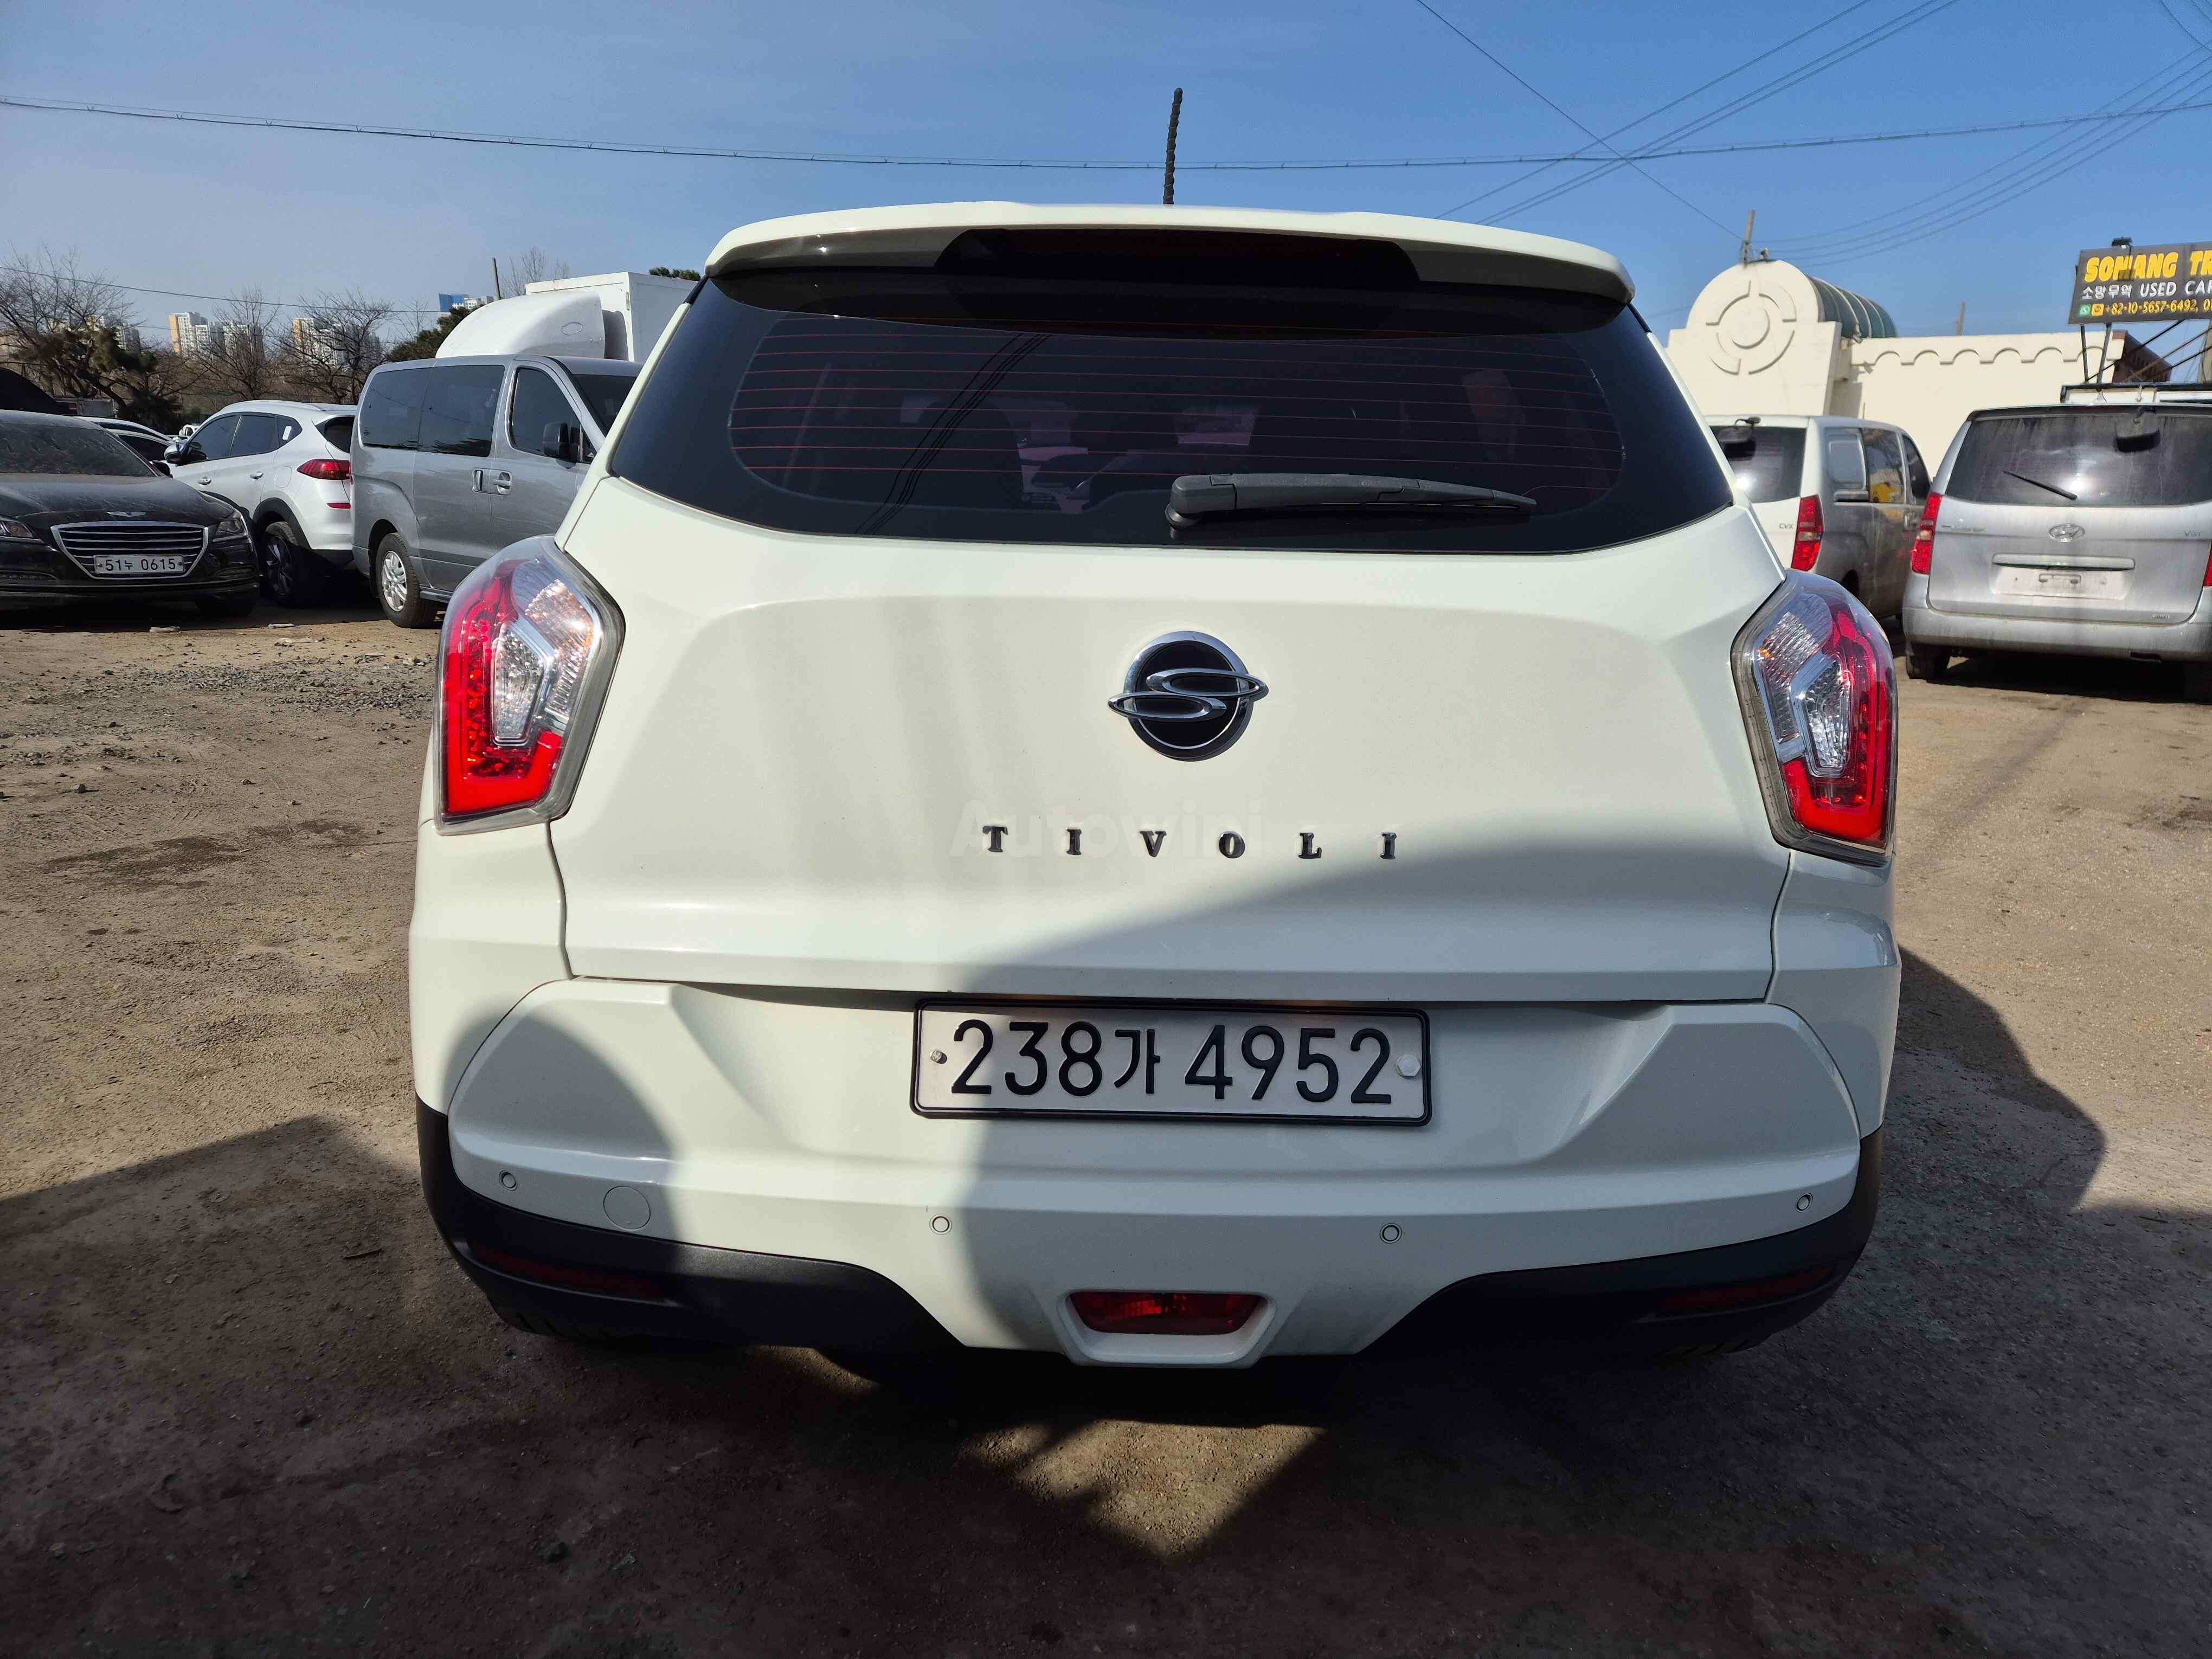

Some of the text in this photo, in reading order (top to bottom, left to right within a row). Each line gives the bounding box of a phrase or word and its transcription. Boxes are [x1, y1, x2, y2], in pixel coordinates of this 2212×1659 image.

[2082, 284, 2132, 299] 소망무역
[2140, 282, 2177, 298] USED
[105, 558, 176, 571] 51누 0615
[982, 826, 1398, 860] TIVOLI
[950, 1018, 1392, 1104] 238가 4952
